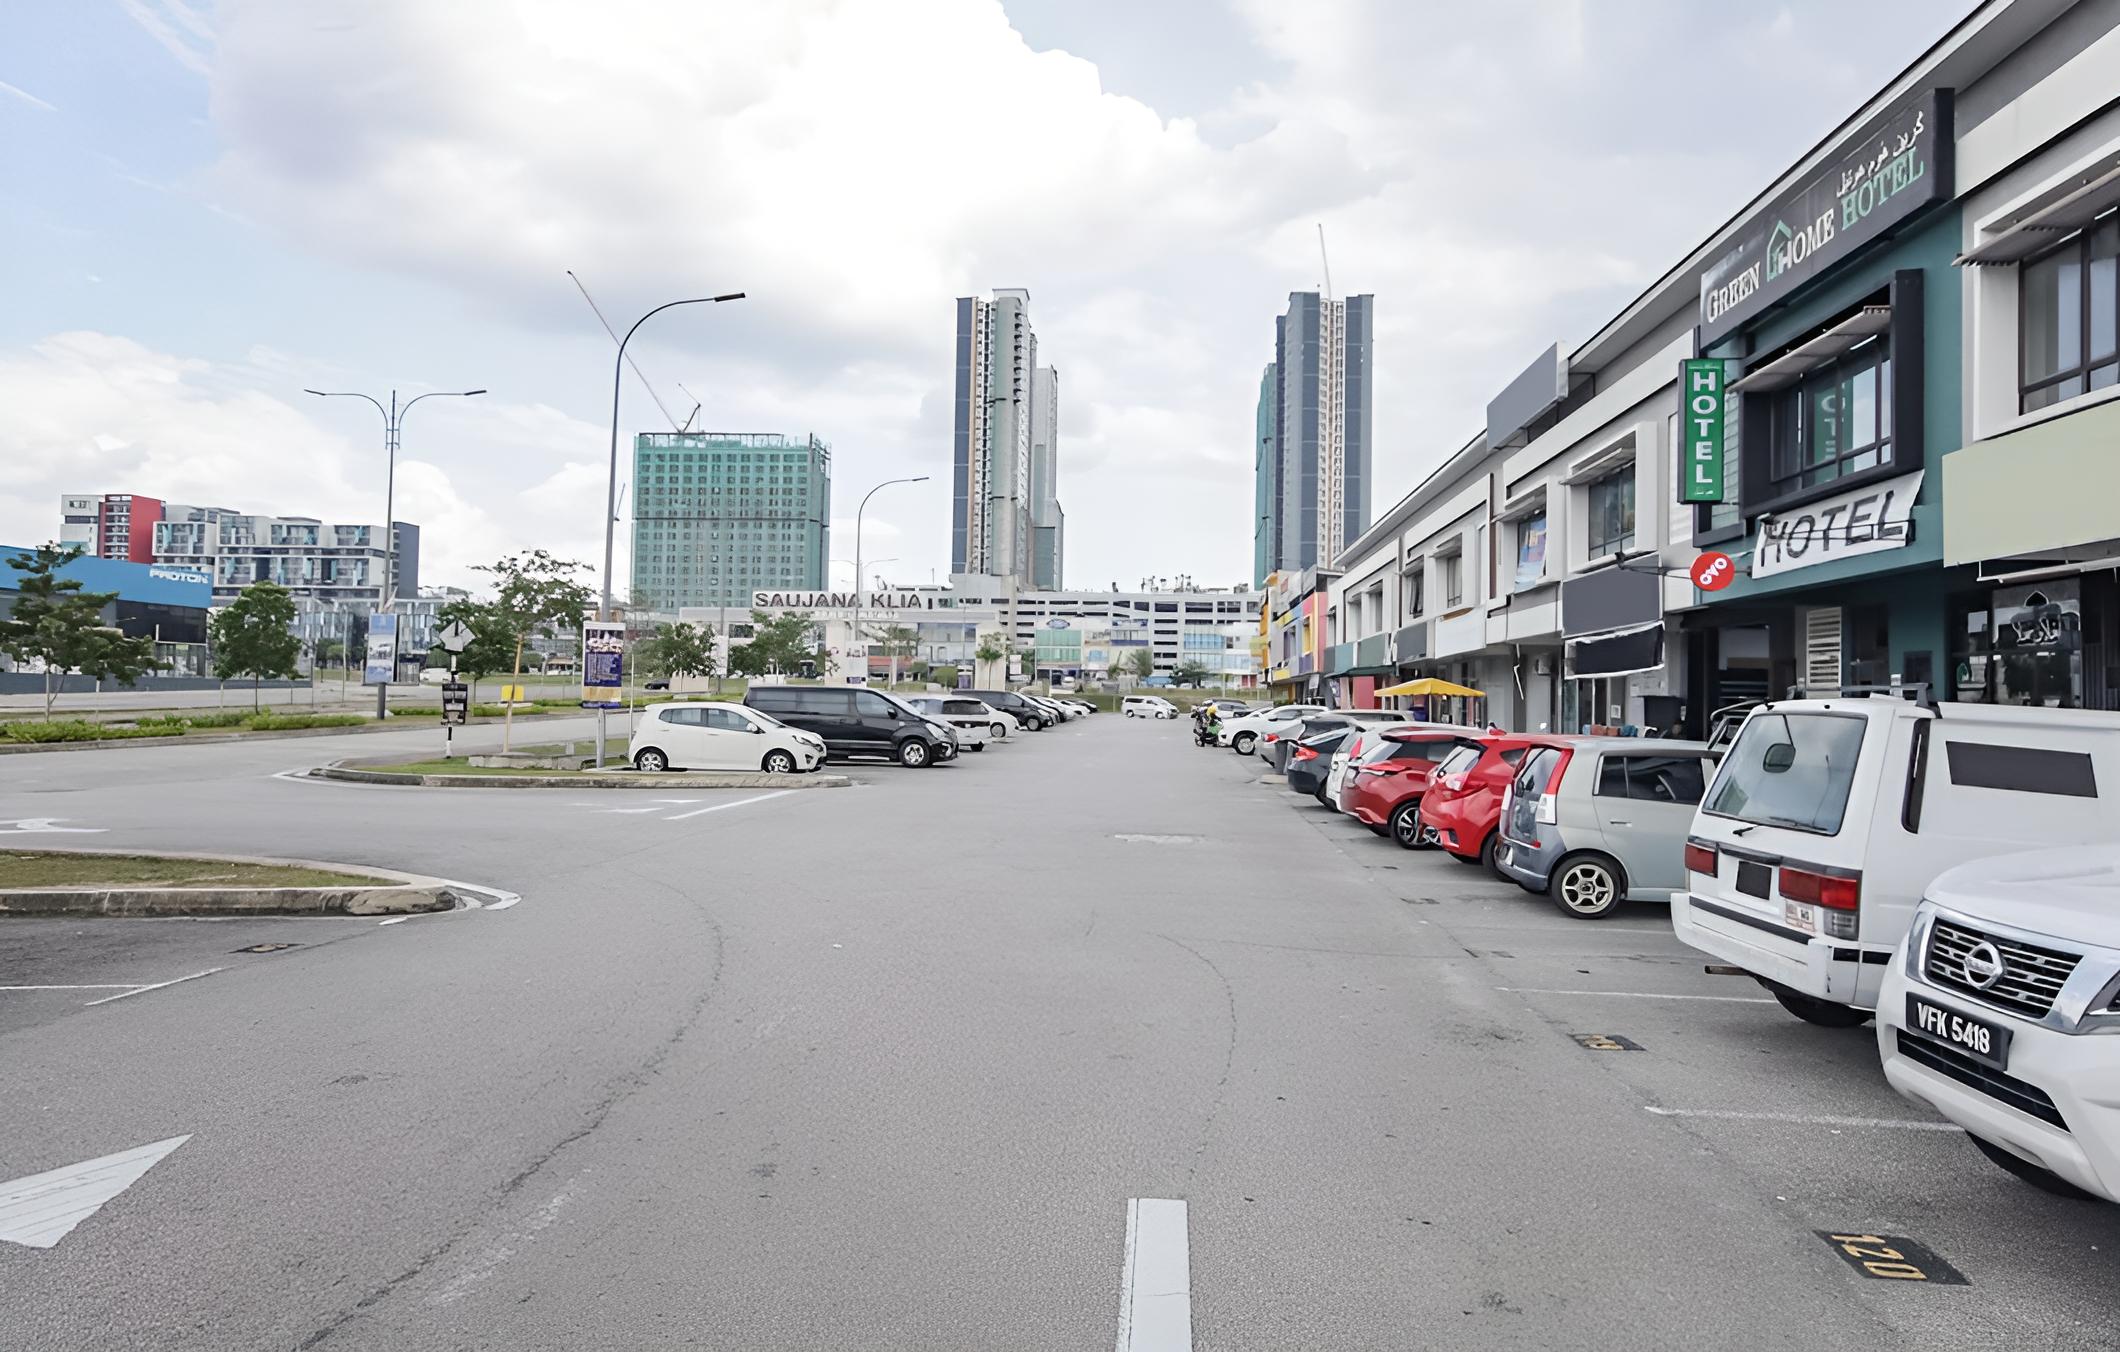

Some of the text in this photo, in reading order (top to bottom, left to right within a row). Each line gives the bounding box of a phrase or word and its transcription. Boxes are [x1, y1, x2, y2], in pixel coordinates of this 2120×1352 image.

[1706, 145, 1924, 324] GREEN HOME HOTEL
[1692, 371, 1717, 484] HOTEL
[1760, 489, 1904, 568] HOTEL
[871, 592, 922, 609] KLIA
[1917, 1002, 1990, 1054] VFK 5418
